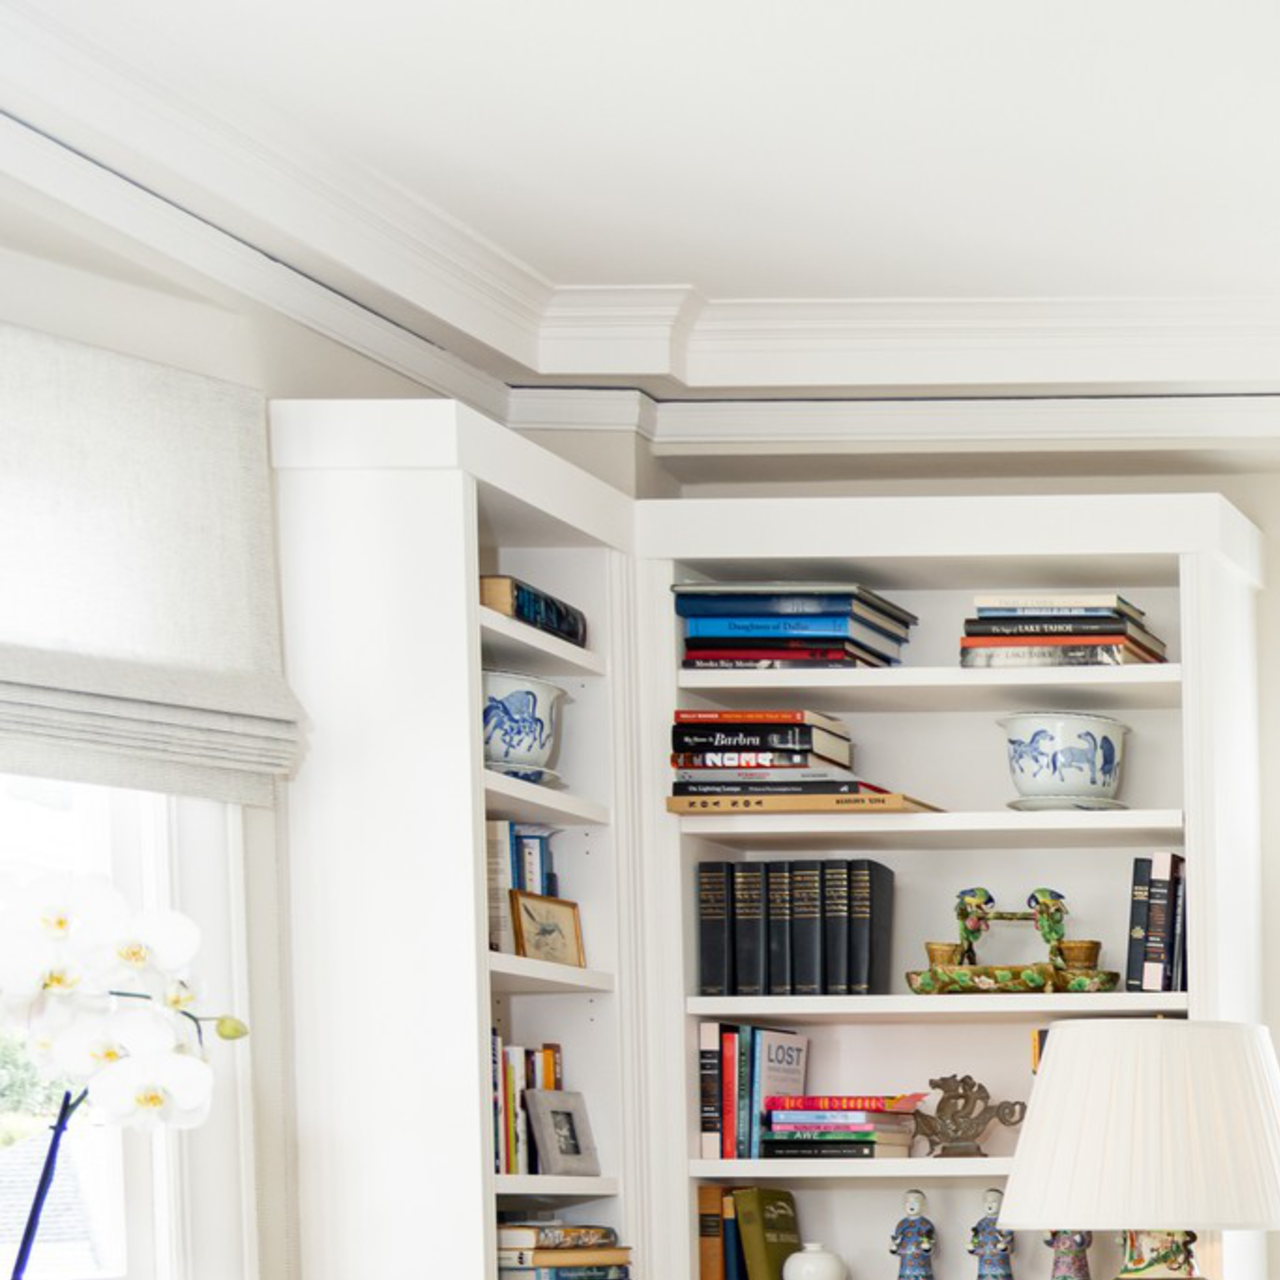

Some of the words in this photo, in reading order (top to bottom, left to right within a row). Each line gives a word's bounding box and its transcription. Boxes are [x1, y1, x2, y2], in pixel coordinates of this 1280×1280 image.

[1018, 624, 1041, 633] LAKE
[1043, 624, 1073, 632] TAHOE
[713, 732, 760, 747] Barbra
[767, 1043, 803, 1066] LOST
[793, 1131, 820, 1140] AWE
